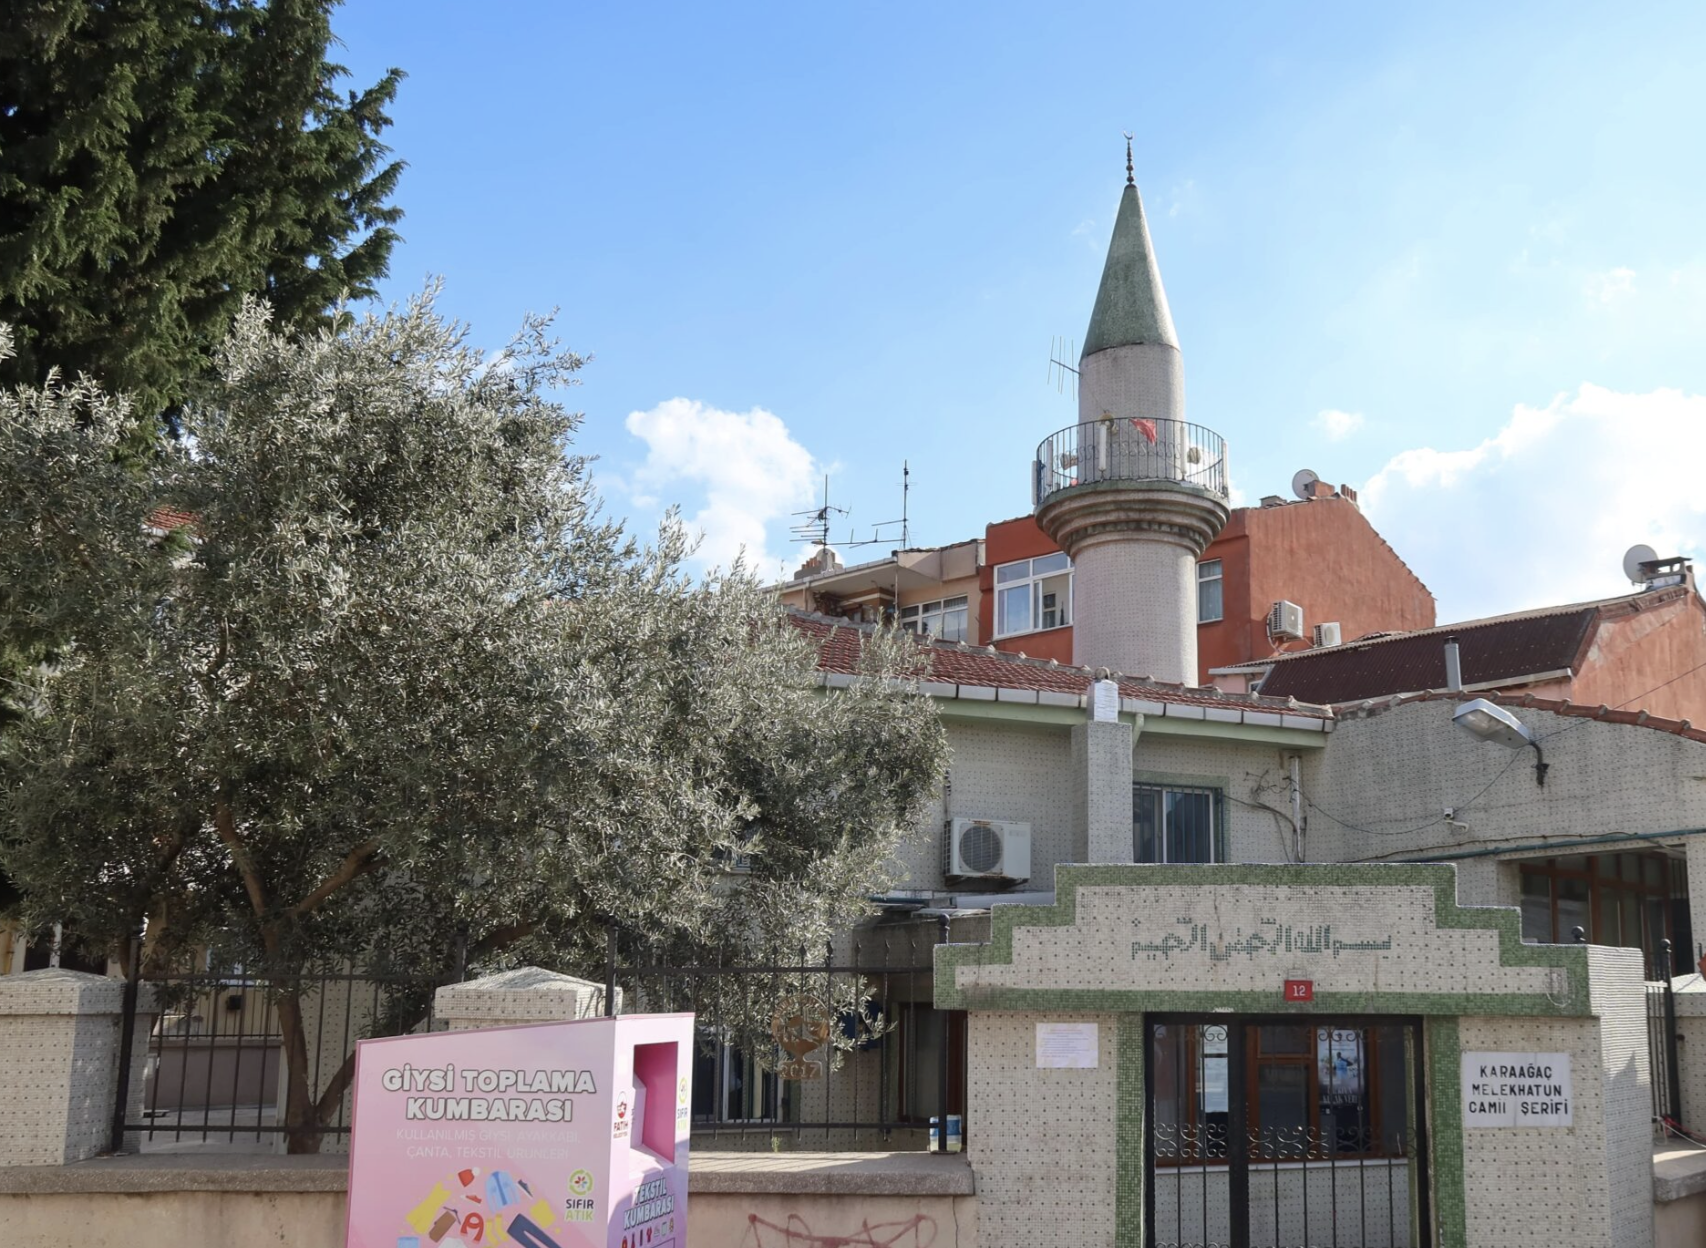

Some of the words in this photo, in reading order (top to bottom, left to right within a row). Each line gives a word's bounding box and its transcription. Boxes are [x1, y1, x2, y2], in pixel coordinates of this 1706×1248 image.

[1292, 984, 1306, 997] 12
[382, 1063, 455, 1092] GİYSİ
[461, 1069, 597, 1094] TOPLAMA
[1480, 1063, 1552, 1081] KARAAĞAÇ
[1472, 1084, 1562, 1096] MELEKHATUN
[406, 1097, 573, 1122] KUMBARASI
[1521, 1099, 1568, 1115] ŞERİFİ
[566, 1199, 594, 1209] SIFIR
[565, 1210, 593, 1221] ATIK
[623, 1196, 674, 1231] KUMBARASI
